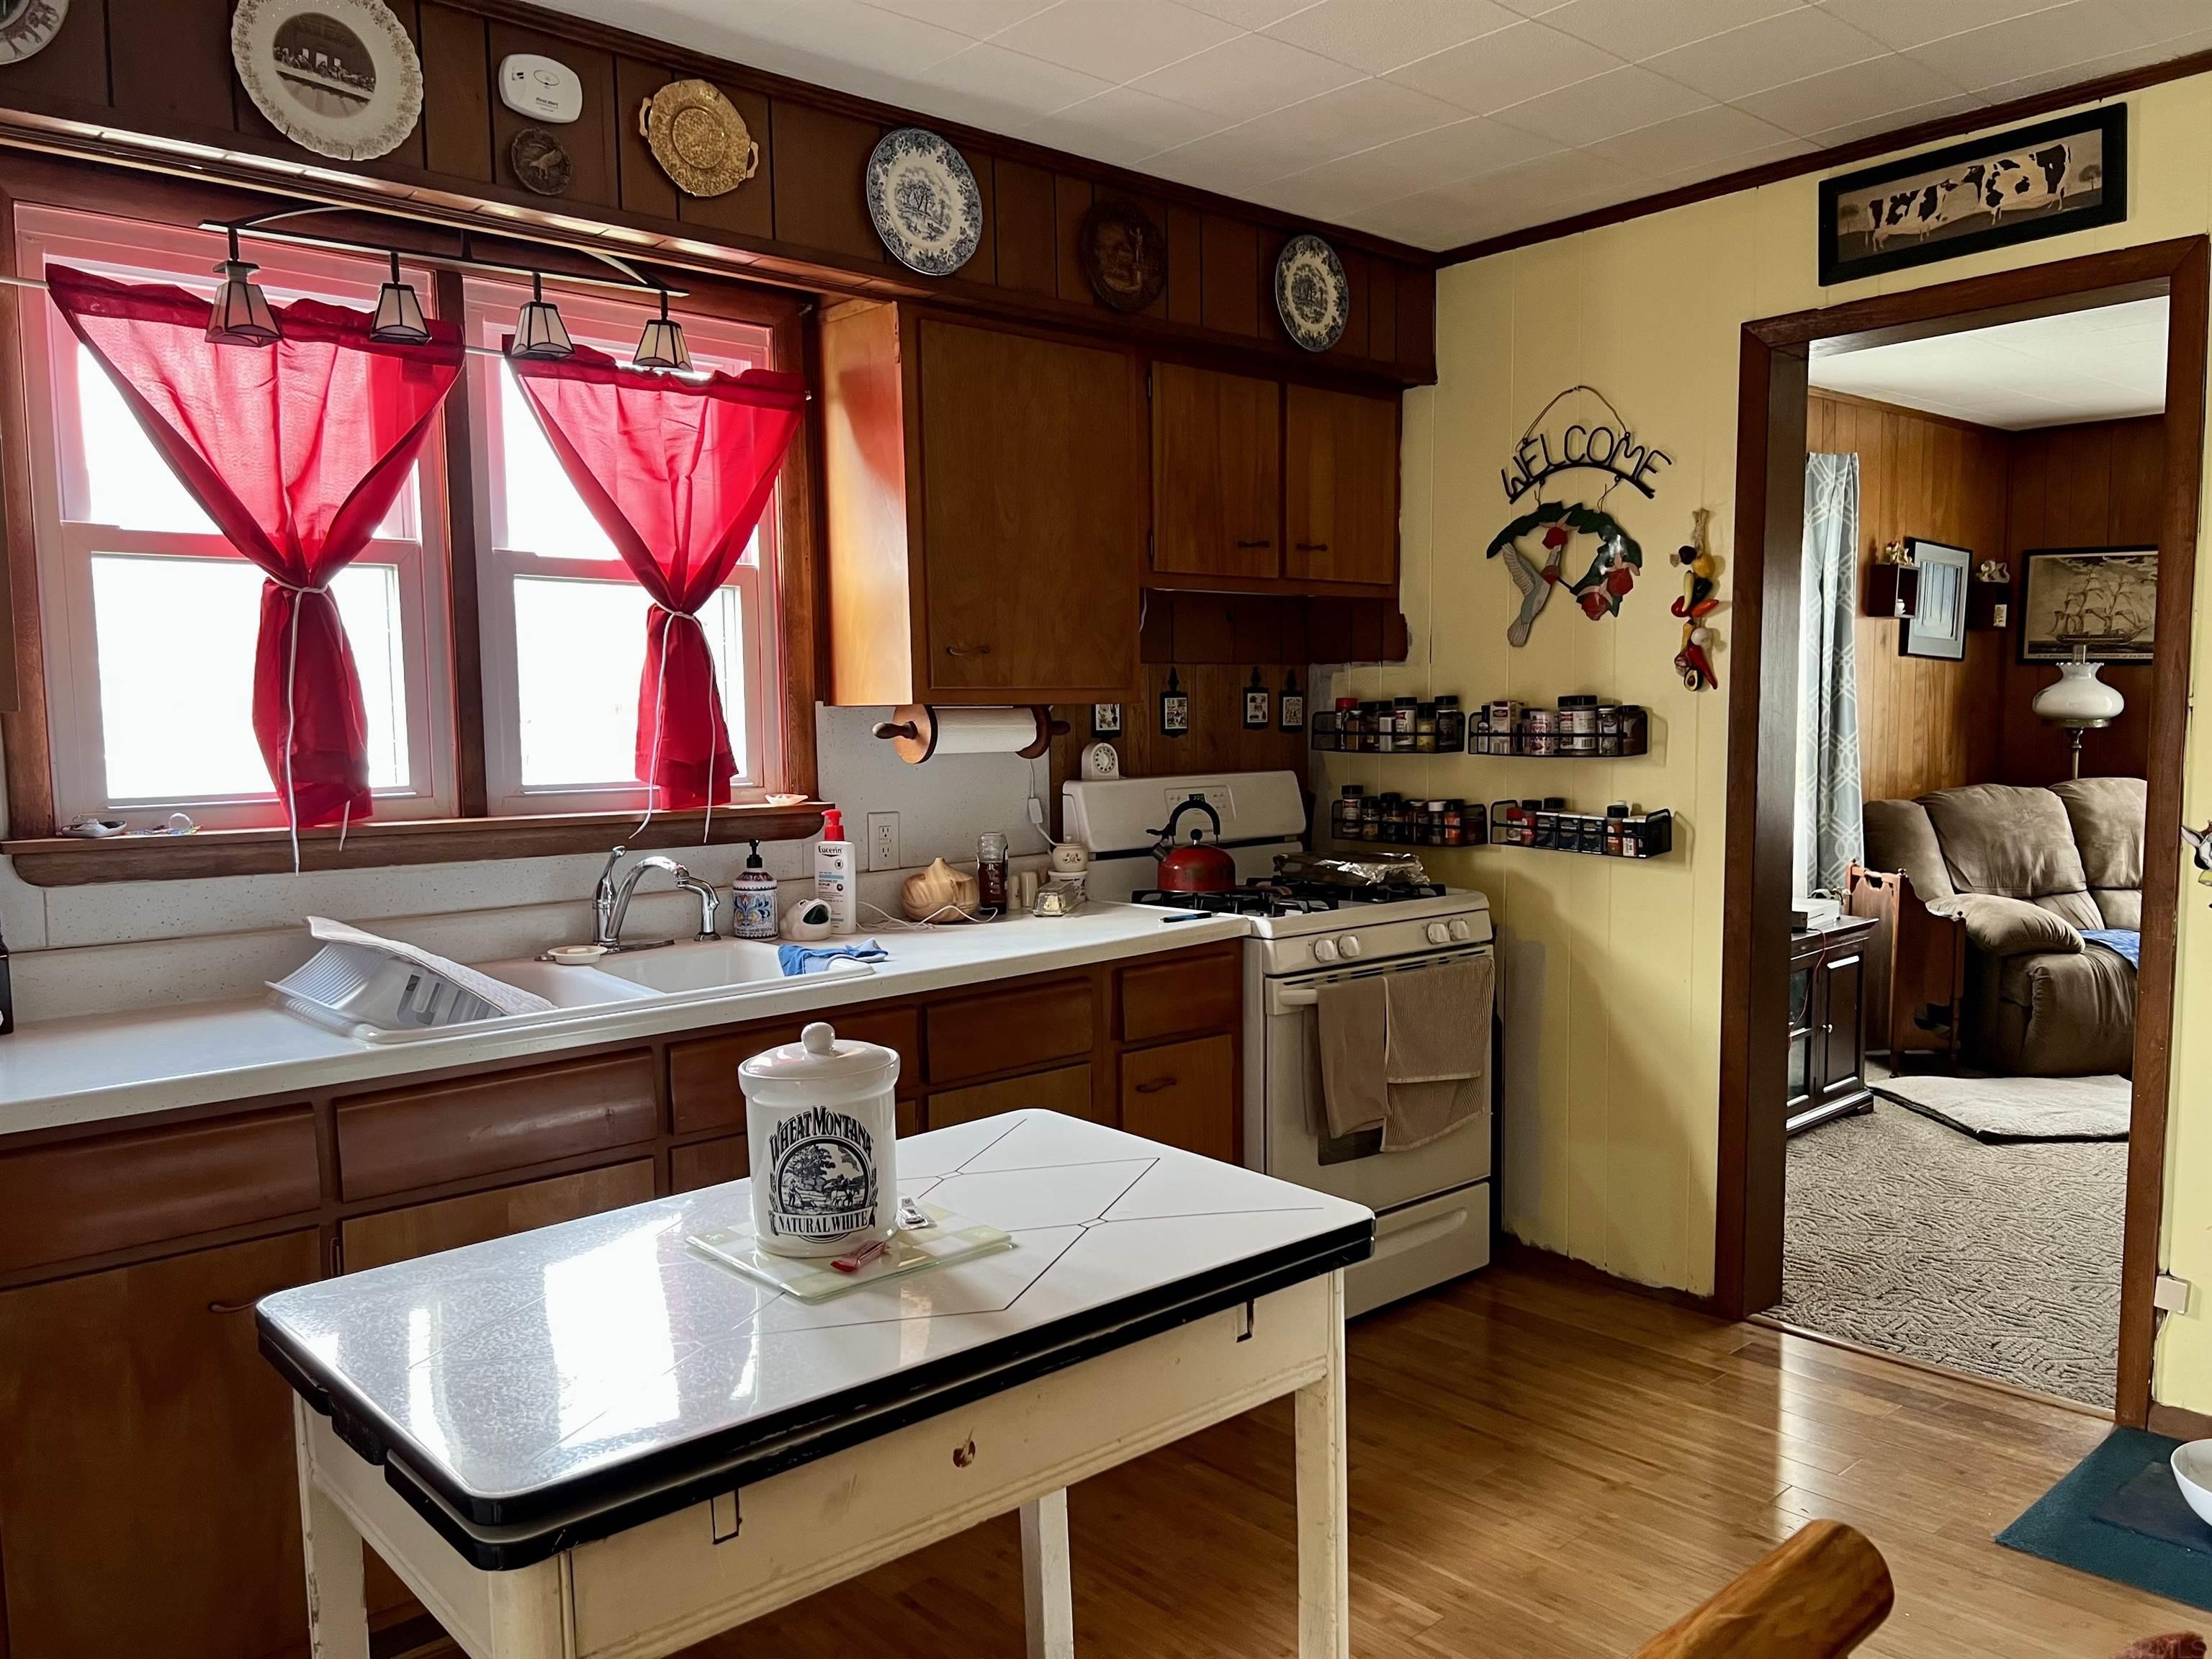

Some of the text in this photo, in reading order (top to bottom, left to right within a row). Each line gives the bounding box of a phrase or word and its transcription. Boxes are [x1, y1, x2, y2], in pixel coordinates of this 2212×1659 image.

[1501, 425, 1672, 498] WELCOME
[818, 845, 842, 854] Eucerin
[769, 1105, 872, 1173] WHEAT MONTANA
[778, 1210, 868, 1233] NATURAL WHITE
